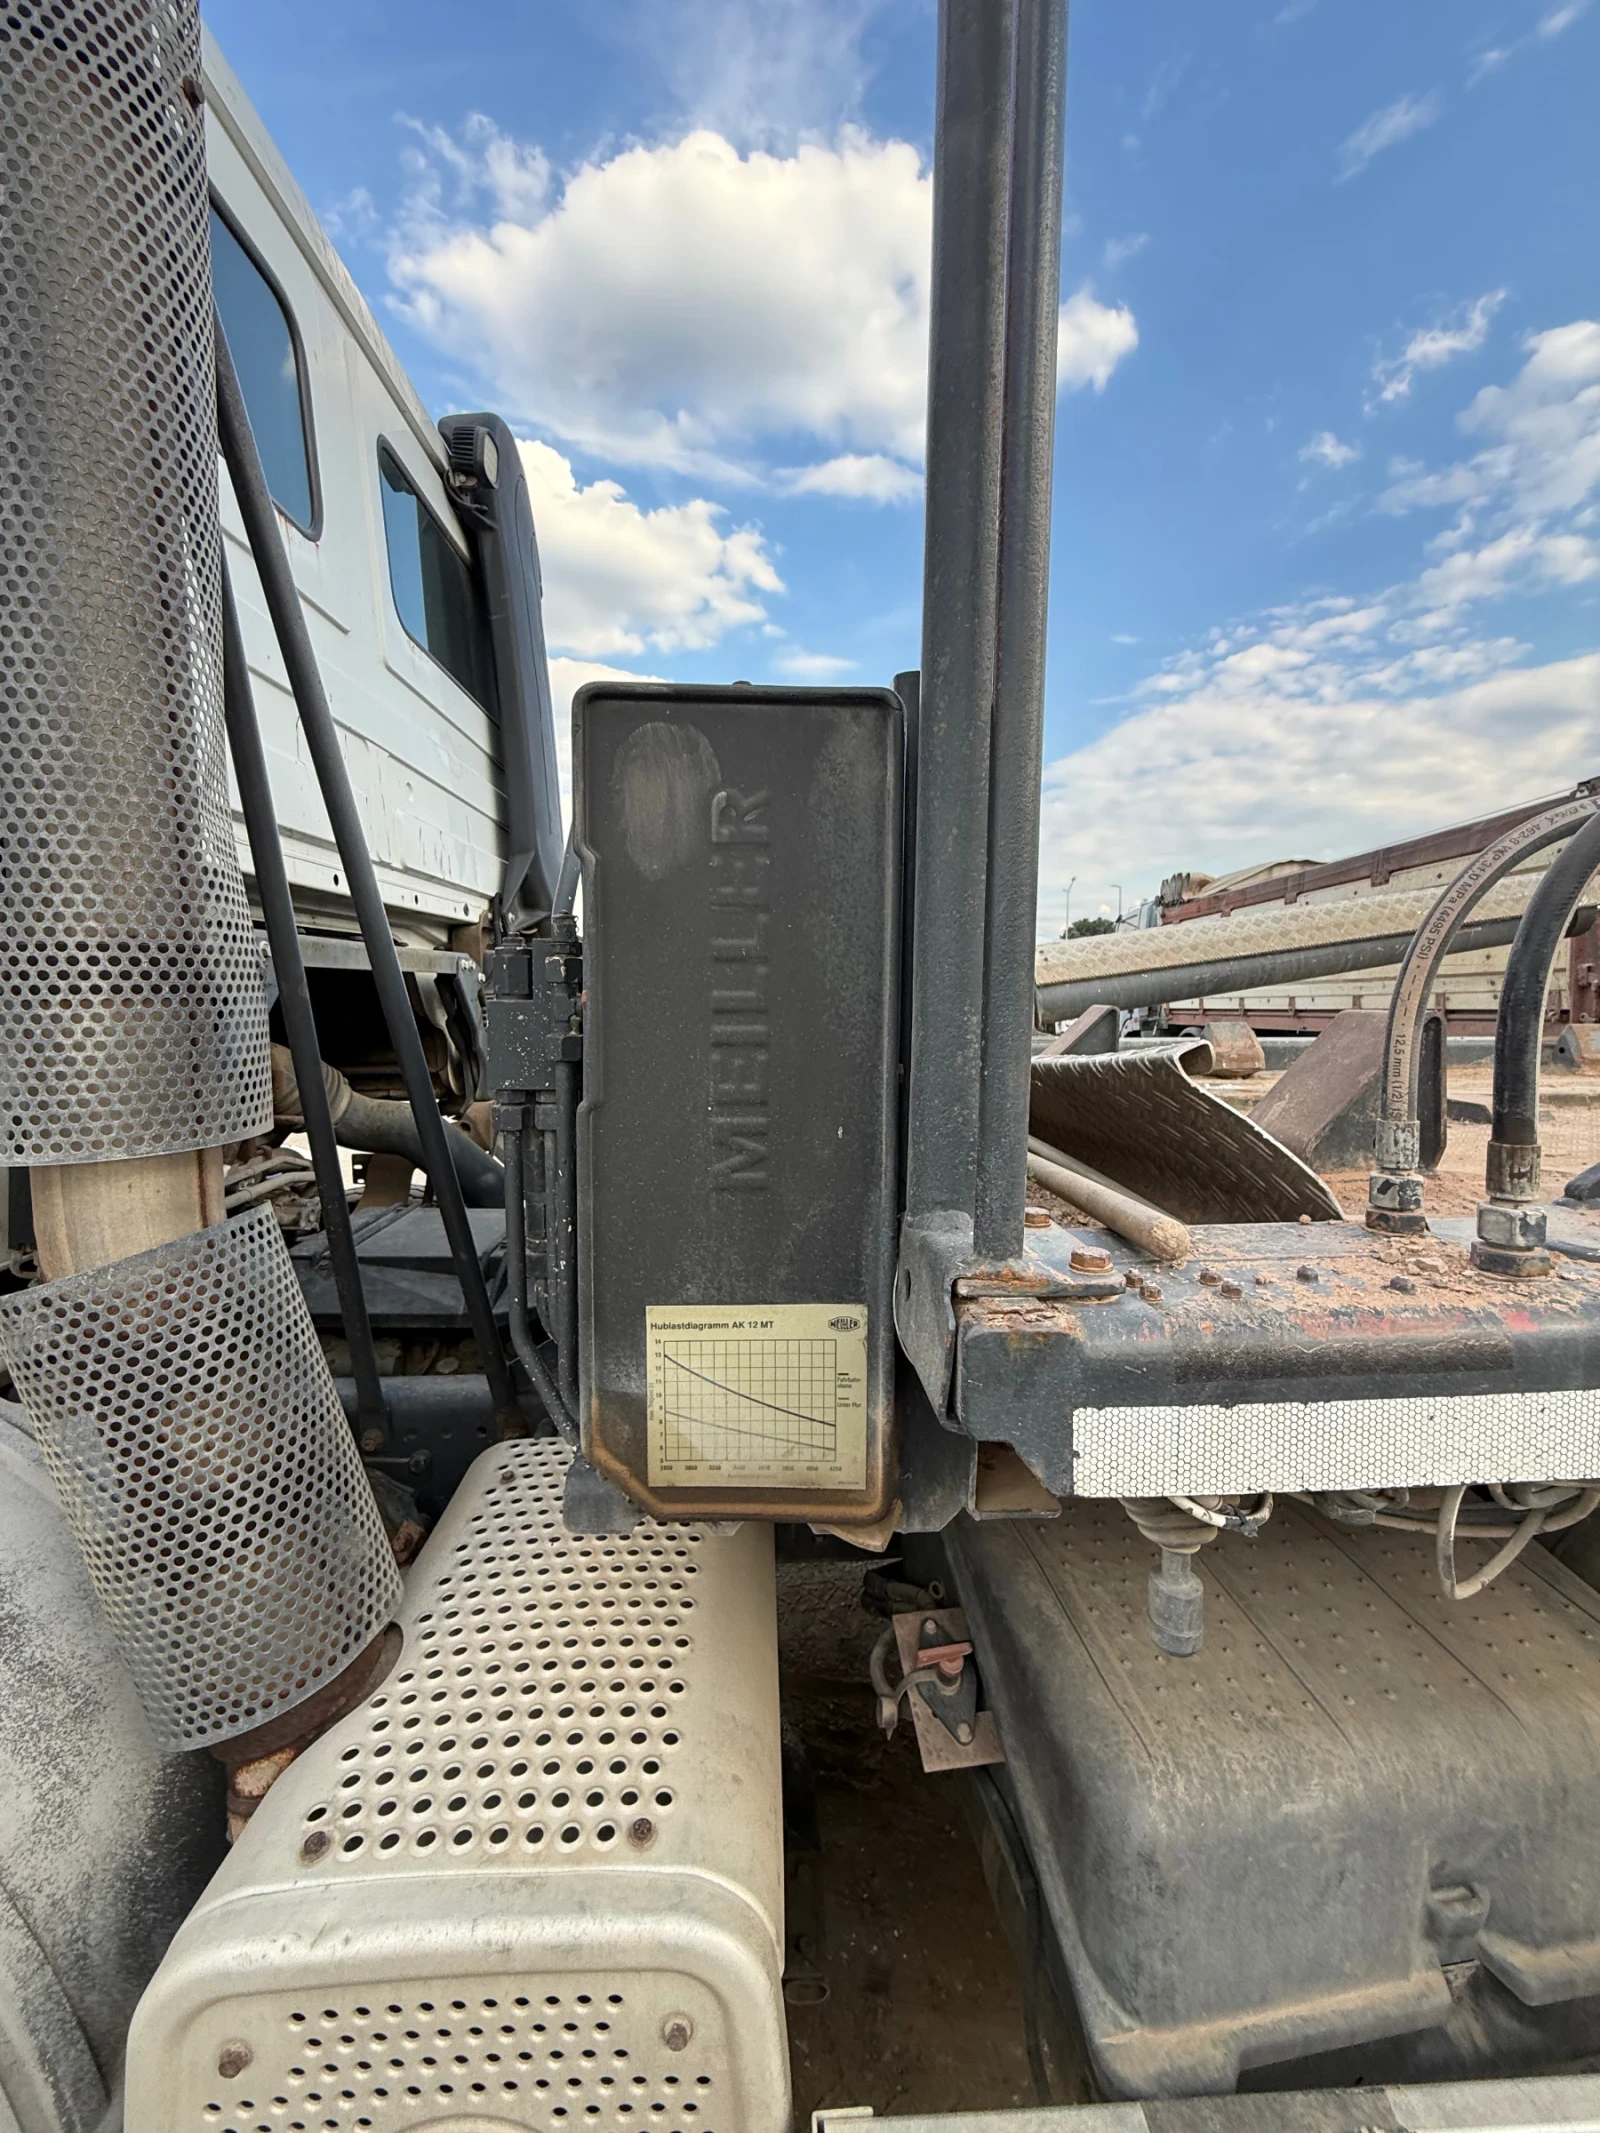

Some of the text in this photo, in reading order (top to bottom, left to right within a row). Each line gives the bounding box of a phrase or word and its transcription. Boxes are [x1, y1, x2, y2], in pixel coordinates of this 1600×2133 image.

[1448, 881, 1473, 904] MPa
[1429, 902, 1455, 936] (4495
[1415, 936, 1435, 960] PSI)
[710, 786, 770, 1193] MEILLER
[1393, 1033, 1406, 1055] 12,5
[1392, 1057, 1402, 1077] mm
[1391, 1080, 1404, 1103] (1/2)
[650, 1320, 774, 1331] Hublastdiagramm AK 12 MT
